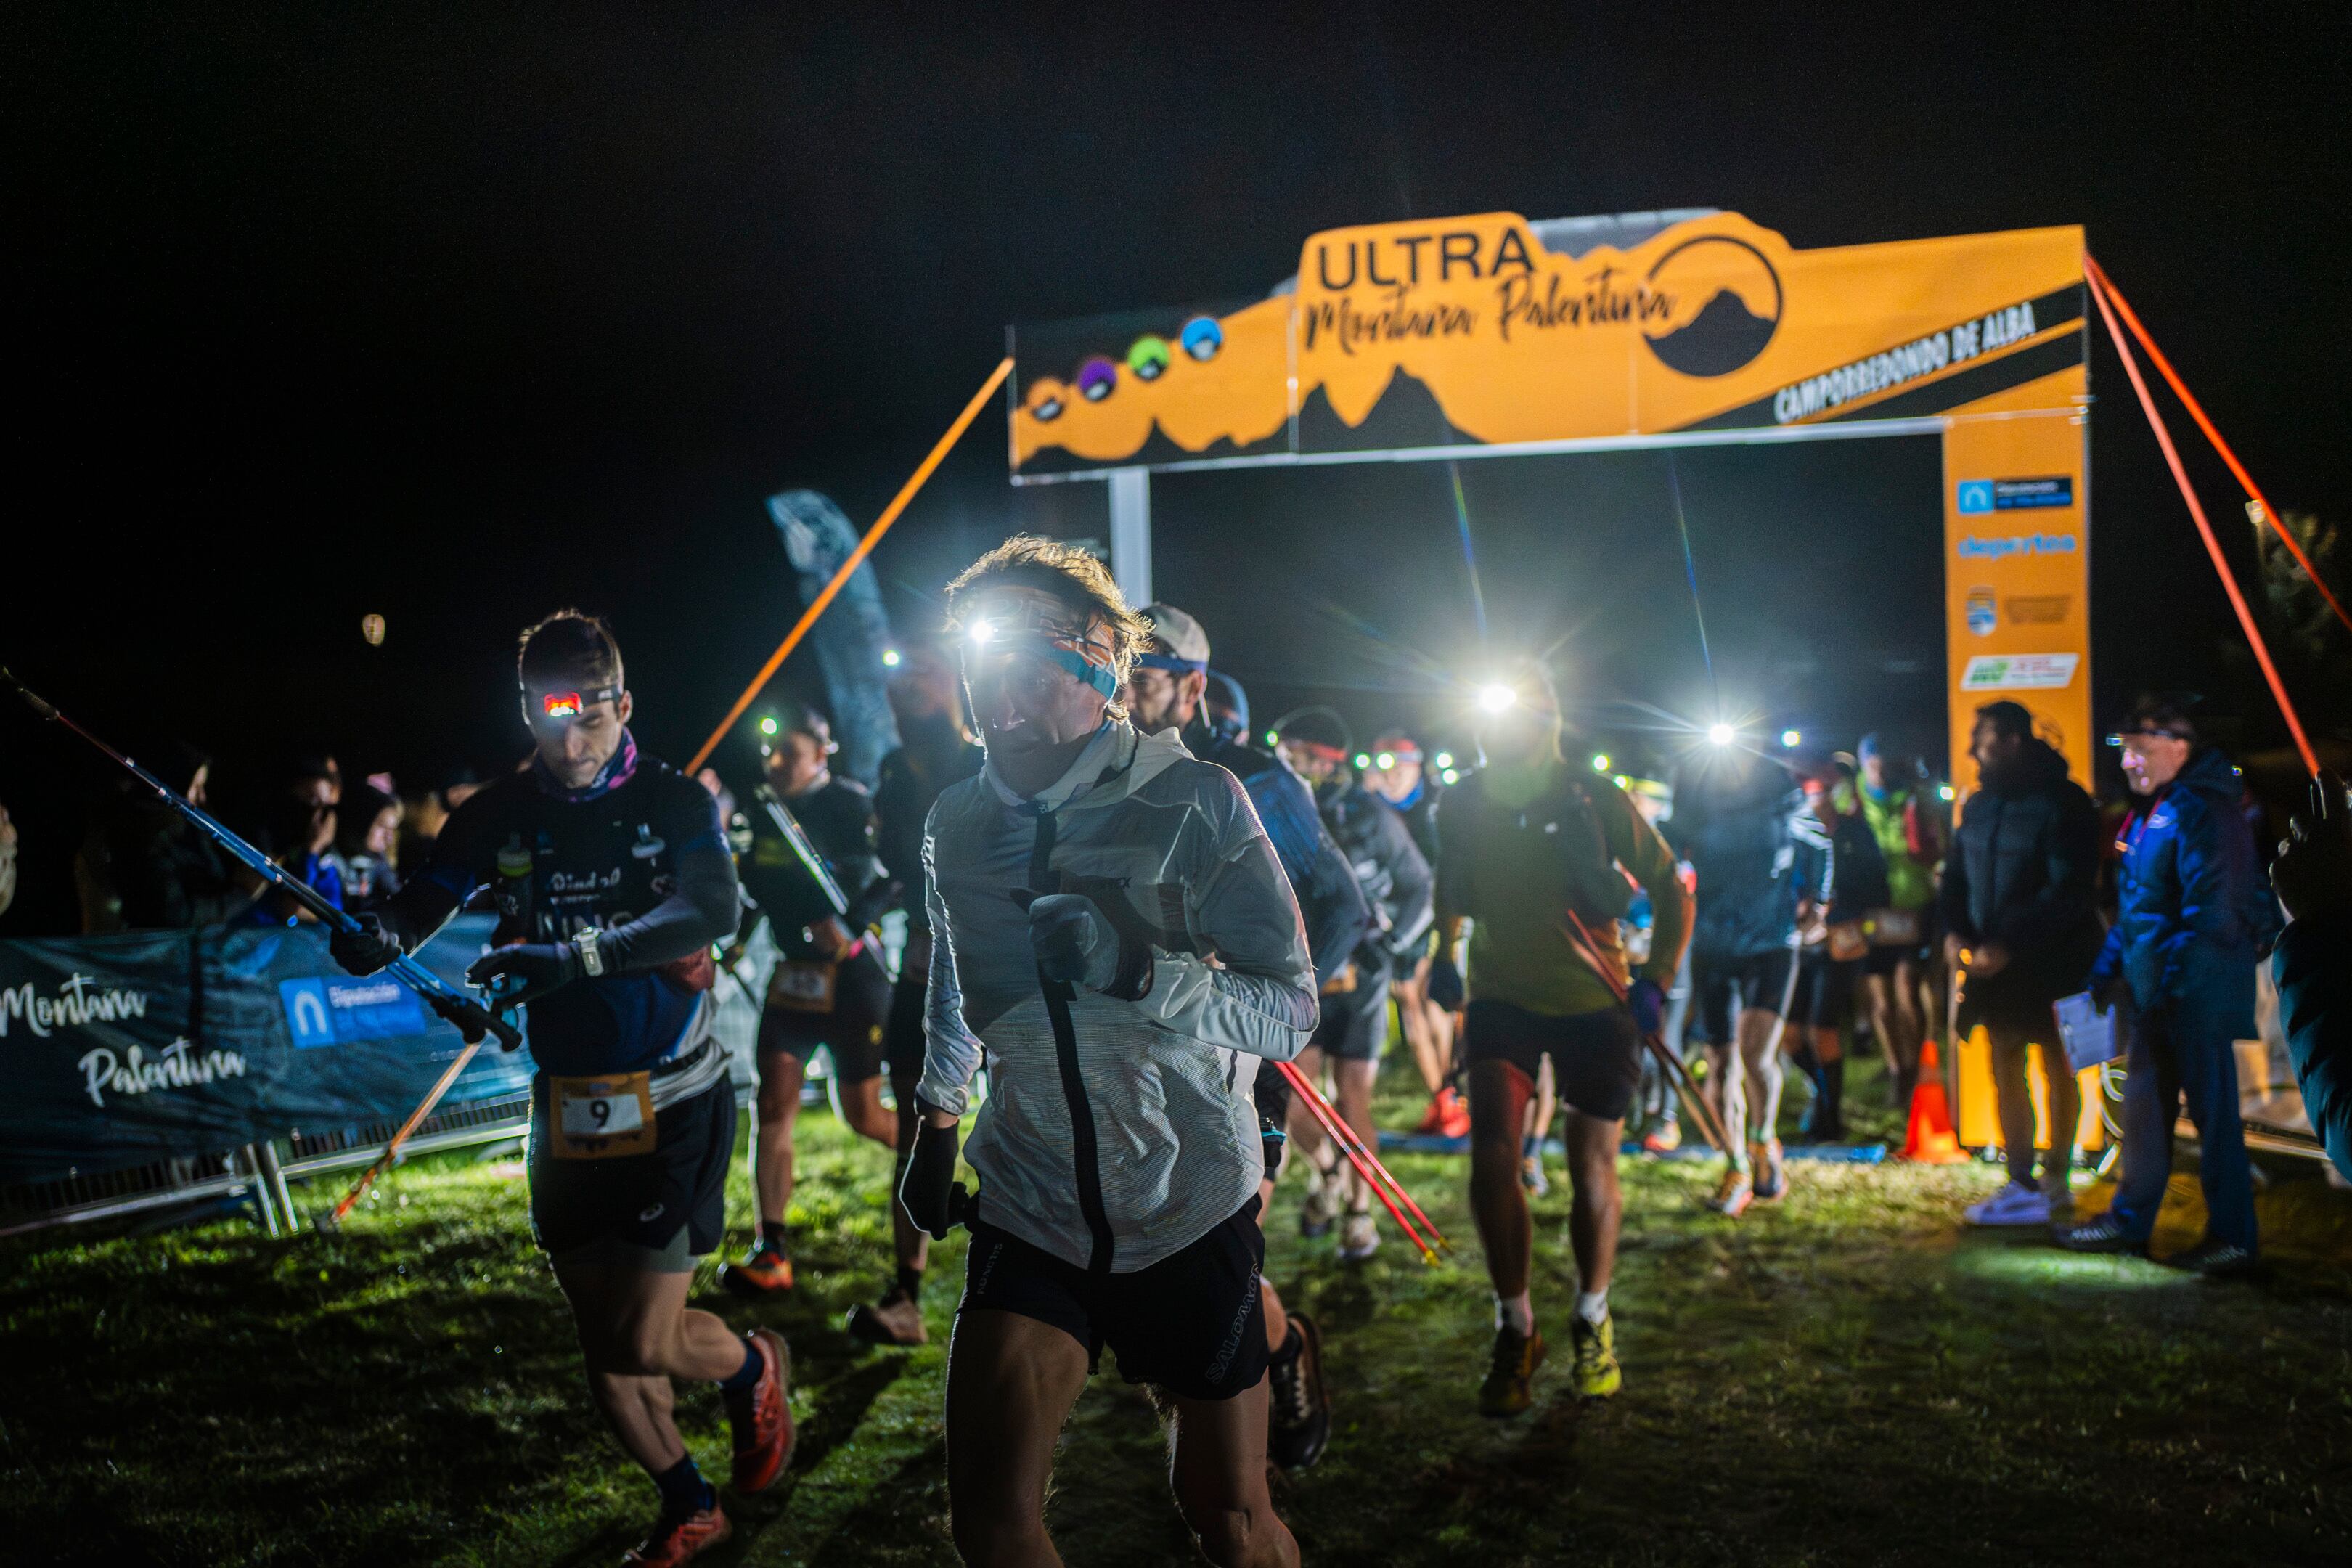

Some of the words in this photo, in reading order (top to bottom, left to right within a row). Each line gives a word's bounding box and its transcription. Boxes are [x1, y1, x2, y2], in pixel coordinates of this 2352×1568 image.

[1319, 226, 1535, 291] ULTRA
[1951, 319, 1981, 362] DE
[1981, 301, 2035, 351] ALBA
[77, 1035, 247, 1108] Palentina
[590, 1100, 609, 1127] 9
